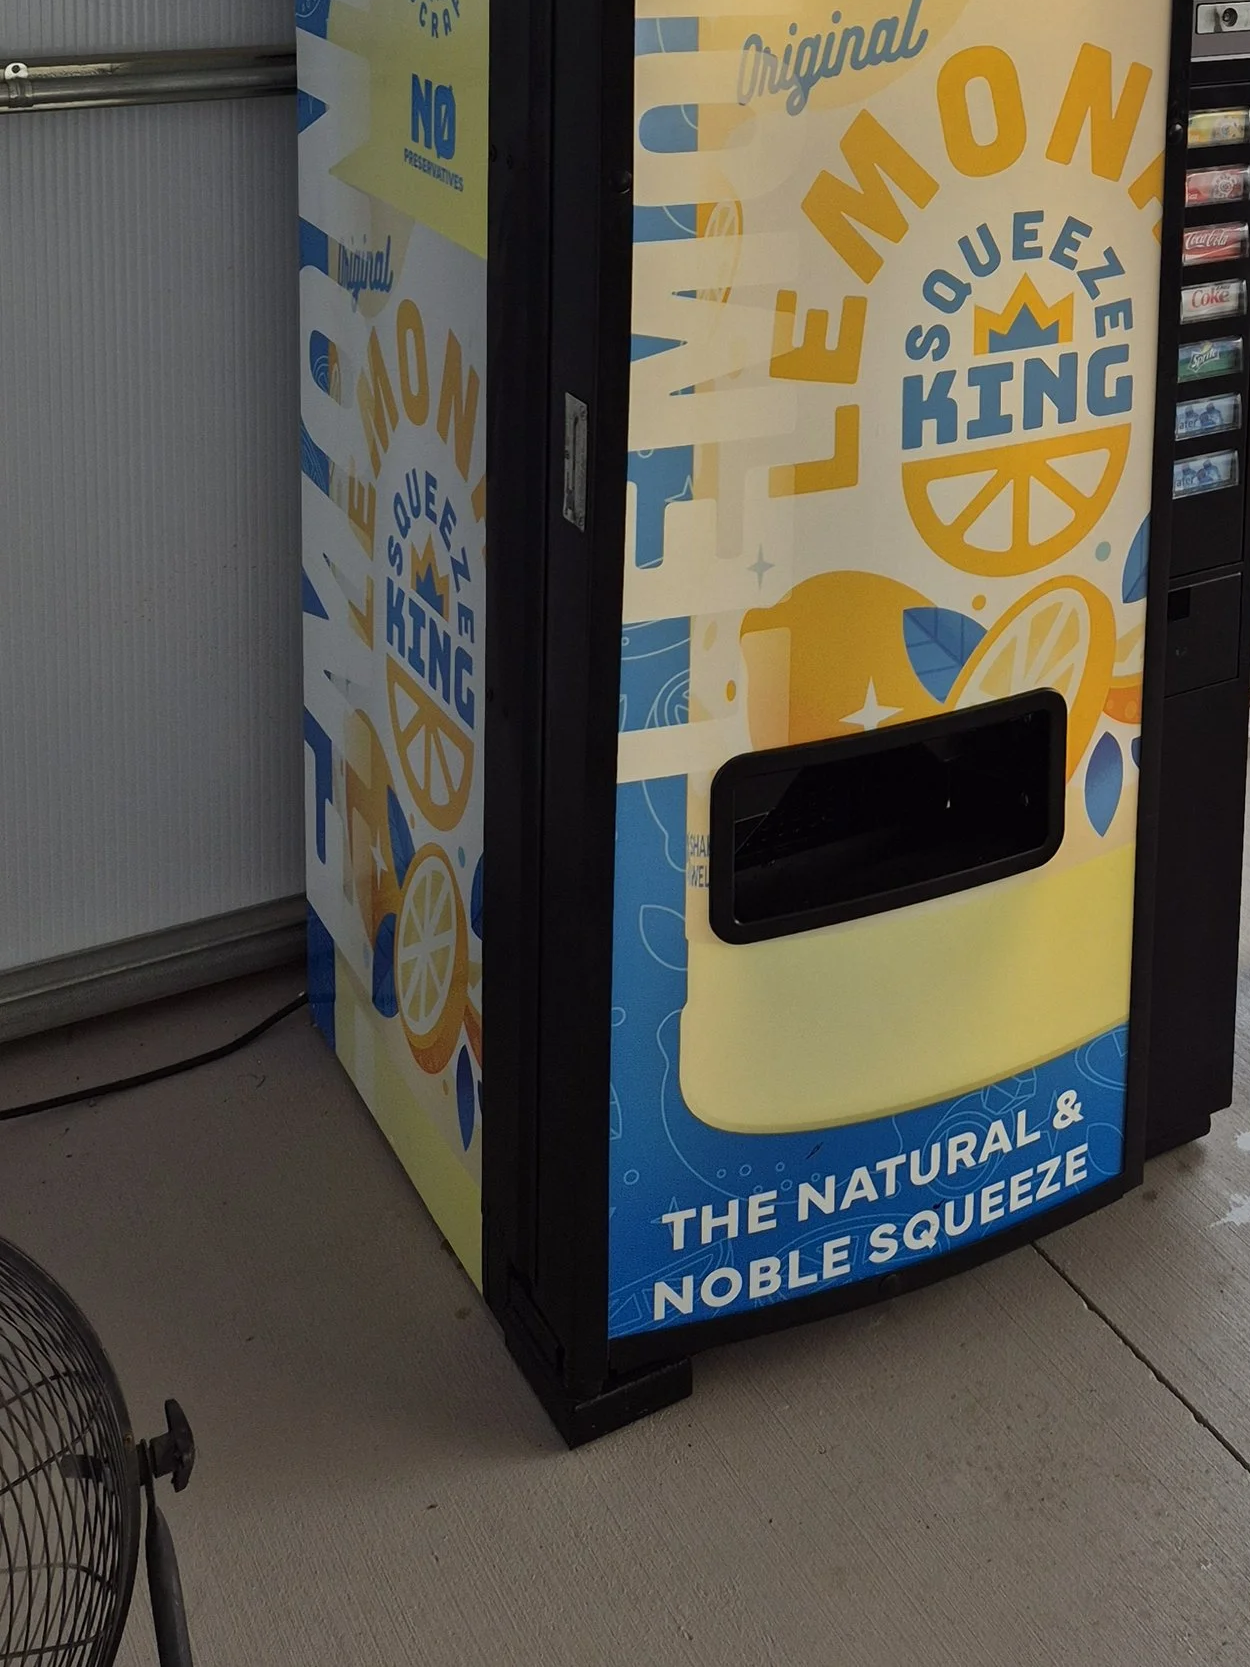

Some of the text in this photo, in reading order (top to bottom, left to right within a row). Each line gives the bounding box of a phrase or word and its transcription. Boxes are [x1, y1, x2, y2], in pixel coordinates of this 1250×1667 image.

[404, 148, 464, 192] PRESERVATIVES
[904, 210, 1133, 362] SQUEEZE
[1191, 347, 1218, 368] Sprite
[1192, 287, 1230, 308] Coke
[902, 344, 1132, 450] KING
[387, 468, 475, 644] SQUEEZE
[386, 576, 475, 730] KING
[653, 1143, 1089, 1322] NOBLE SQUEEZE
[661, 1089, 1084, 1251] THE NATURAL &
